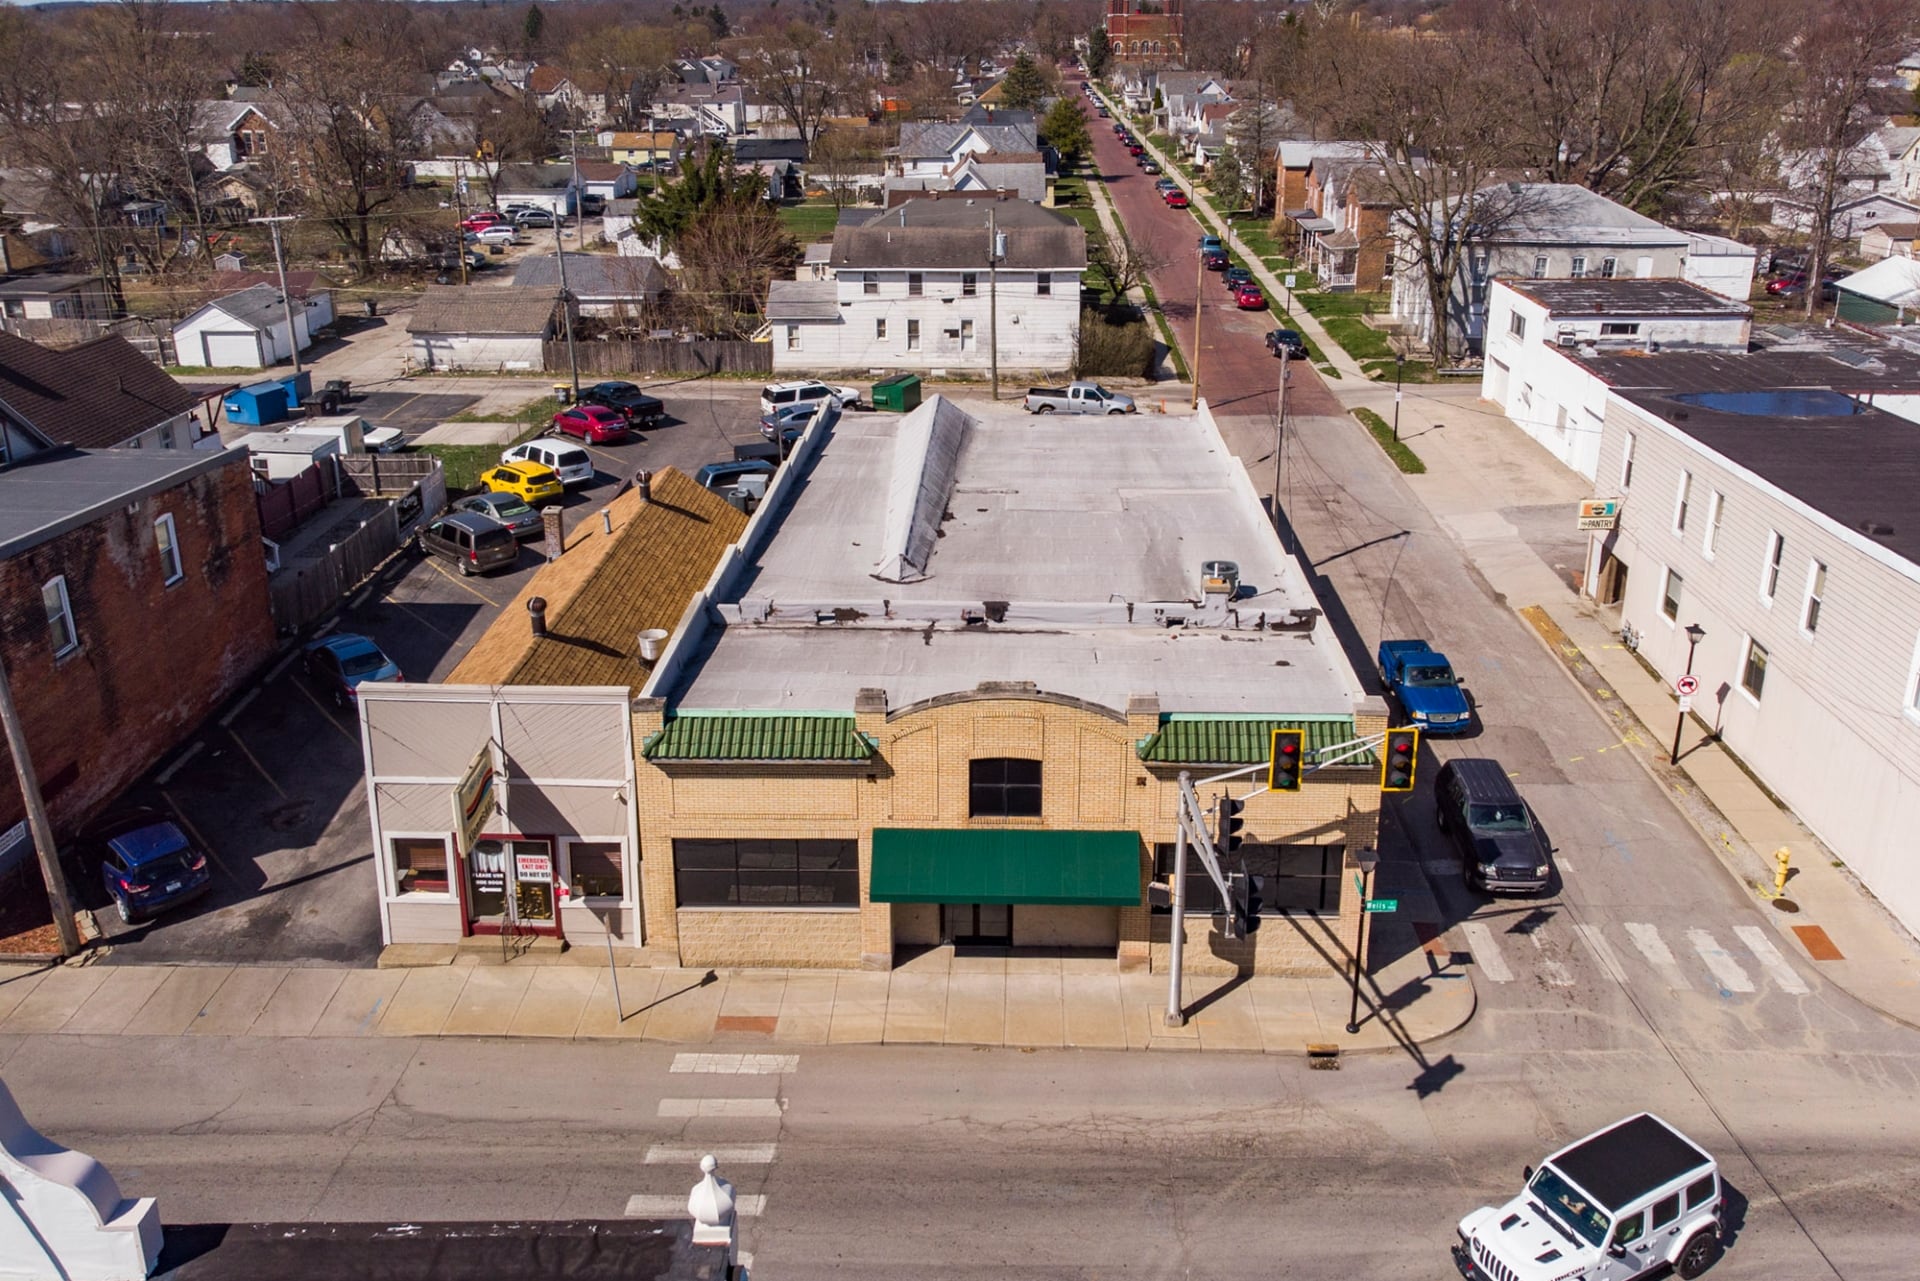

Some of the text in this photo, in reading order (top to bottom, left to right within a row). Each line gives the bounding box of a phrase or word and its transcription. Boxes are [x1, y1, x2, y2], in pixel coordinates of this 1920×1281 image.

[1587, 519, 1614, 528] PANTRY
[1367, 902, 1386, 910] Wells
[1550, 1266, 1586, 1281] UBICON
